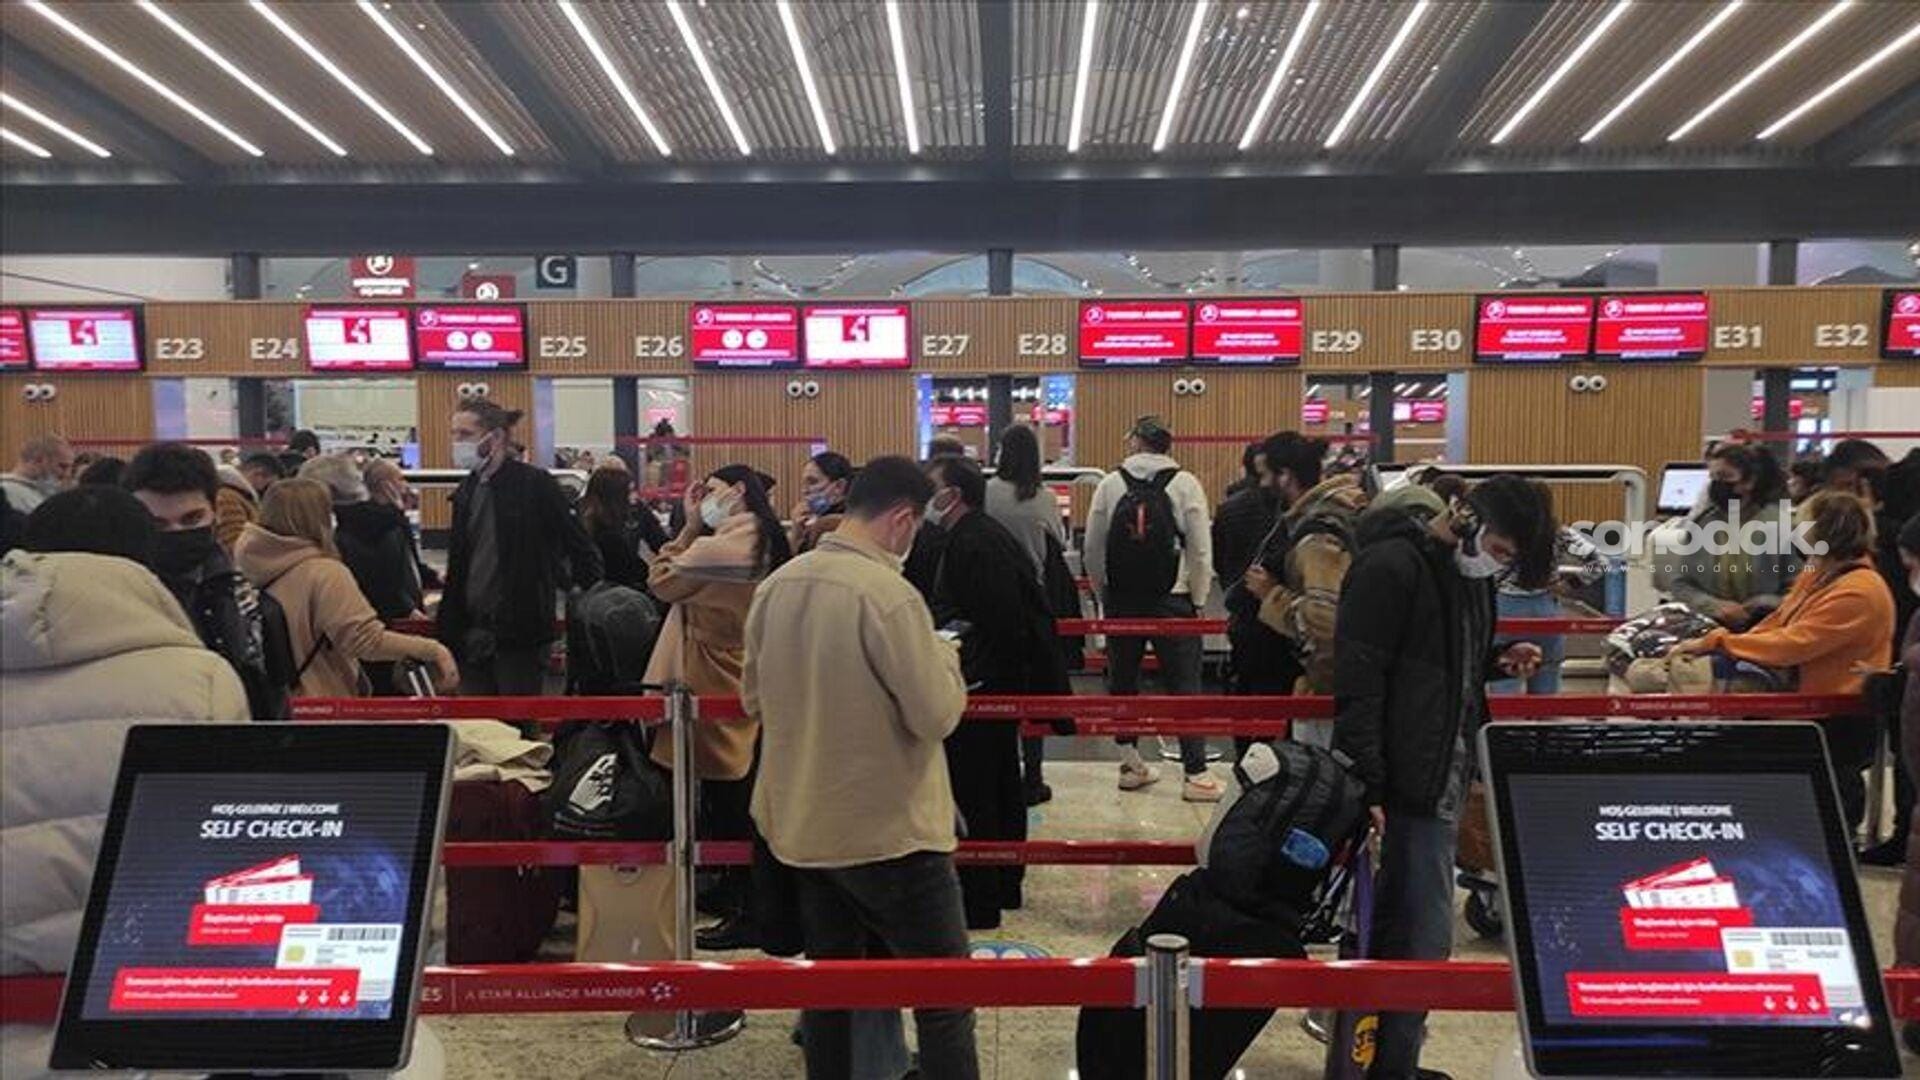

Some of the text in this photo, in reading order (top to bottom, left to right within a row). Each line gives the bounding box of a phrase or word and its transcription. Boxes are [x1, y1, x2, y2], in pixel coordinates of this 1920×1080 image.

[541, 256, 568, 284] G
[636, 336, 684, 357] E26
[922, 335, 969, 356] E27
[1019, 334, 1067, 355] E28
[1312, 330, 1362, 352] E29
[1411, 329, 1462, 351] E30
[1714, 325, 1762, 348] E31
[1816, 324, 1869, 347] E32
[156, 337, 204, 360] E23
[250, 337, 299, 360] E24
[539, 336, 587, 358] E25
[200, 819, 344, 839] SELF CHECK-IN
[1594, 821, 1745, 841] SELF CHECK-IN
